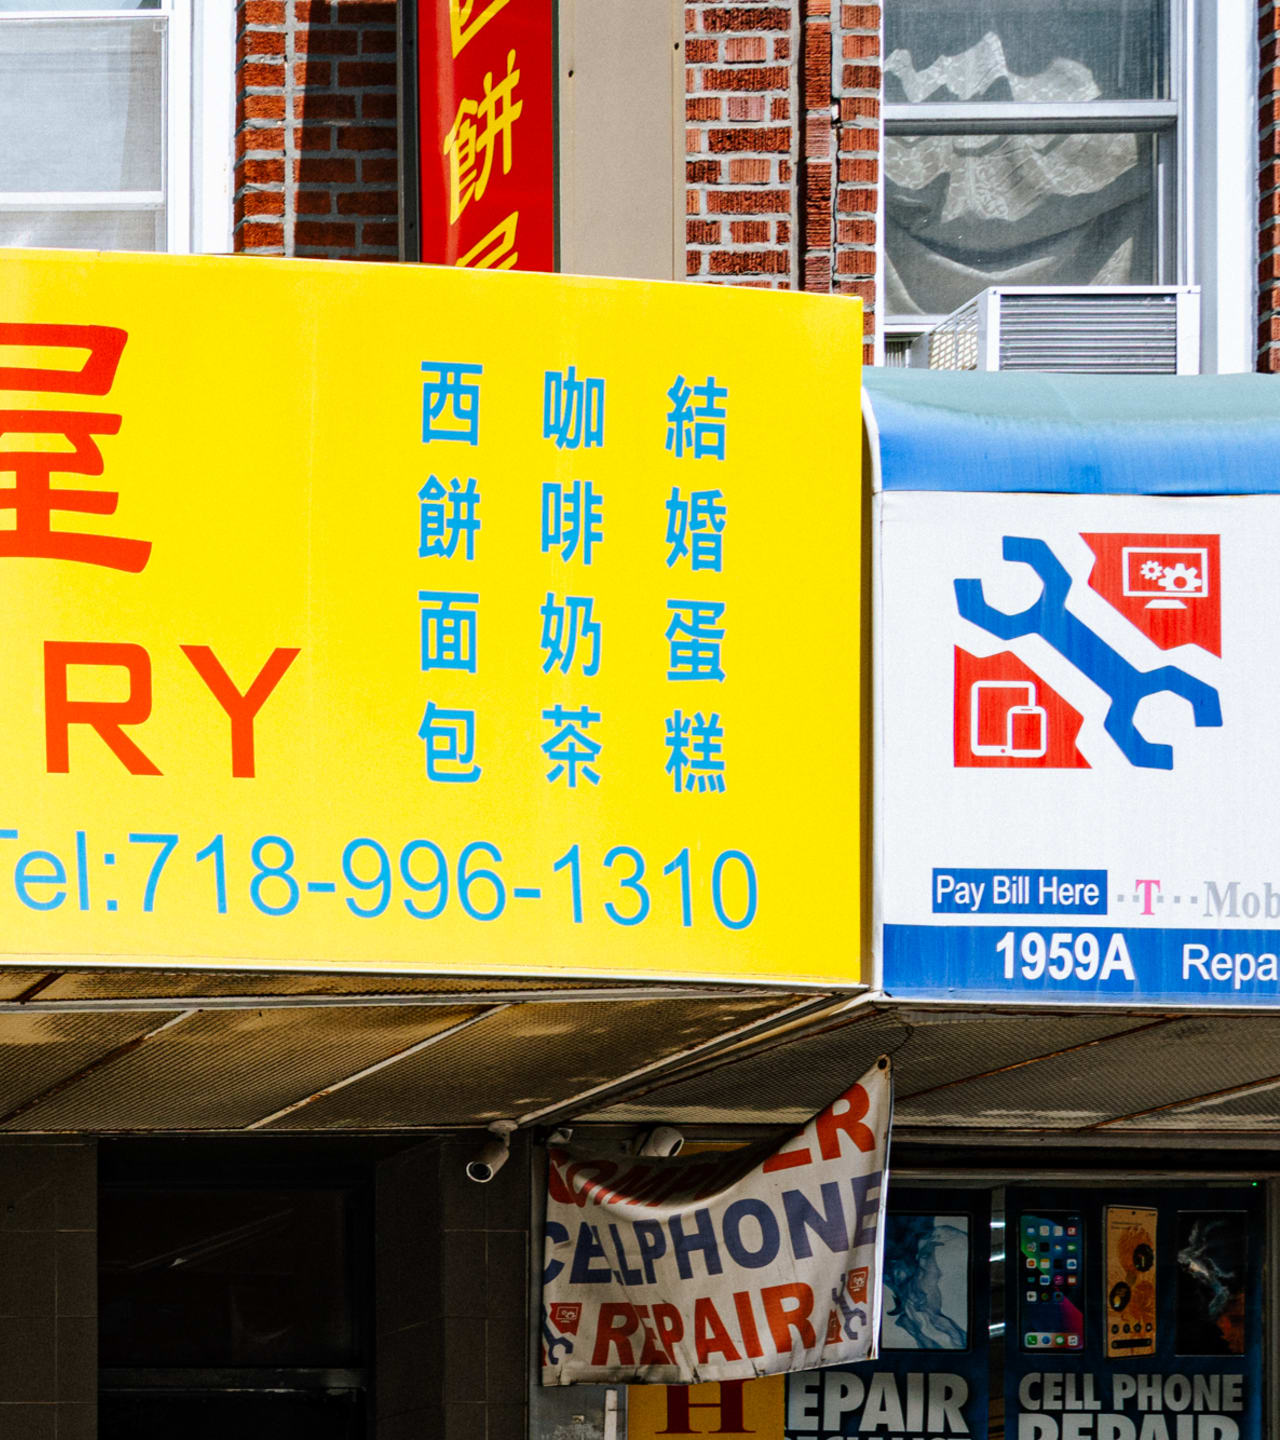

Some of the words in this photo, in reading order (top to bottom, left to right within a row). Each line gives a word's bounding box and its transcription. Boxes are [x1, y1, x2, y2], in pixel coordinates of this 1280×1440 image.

[418, 360, 483, 785] 西餅面包
[540, 366, 606, 788] 咖啡奶茶
[665, 374, 729, 796] 結婚蛋糕
[936, 875, 985, 912] Pay
[993, 877, 1030, 905] Bill
[1039, 877, 1100, 906] Here
[995, 931, 1136, 982] 1959A
[590, 1281, 817, 1367] REPAIR
[784, 1371, 971, 1434] EPAIR
[1017, 1372, 1102, 1412] CELL
[1112, 1372, 1244, 1413] PHONE
